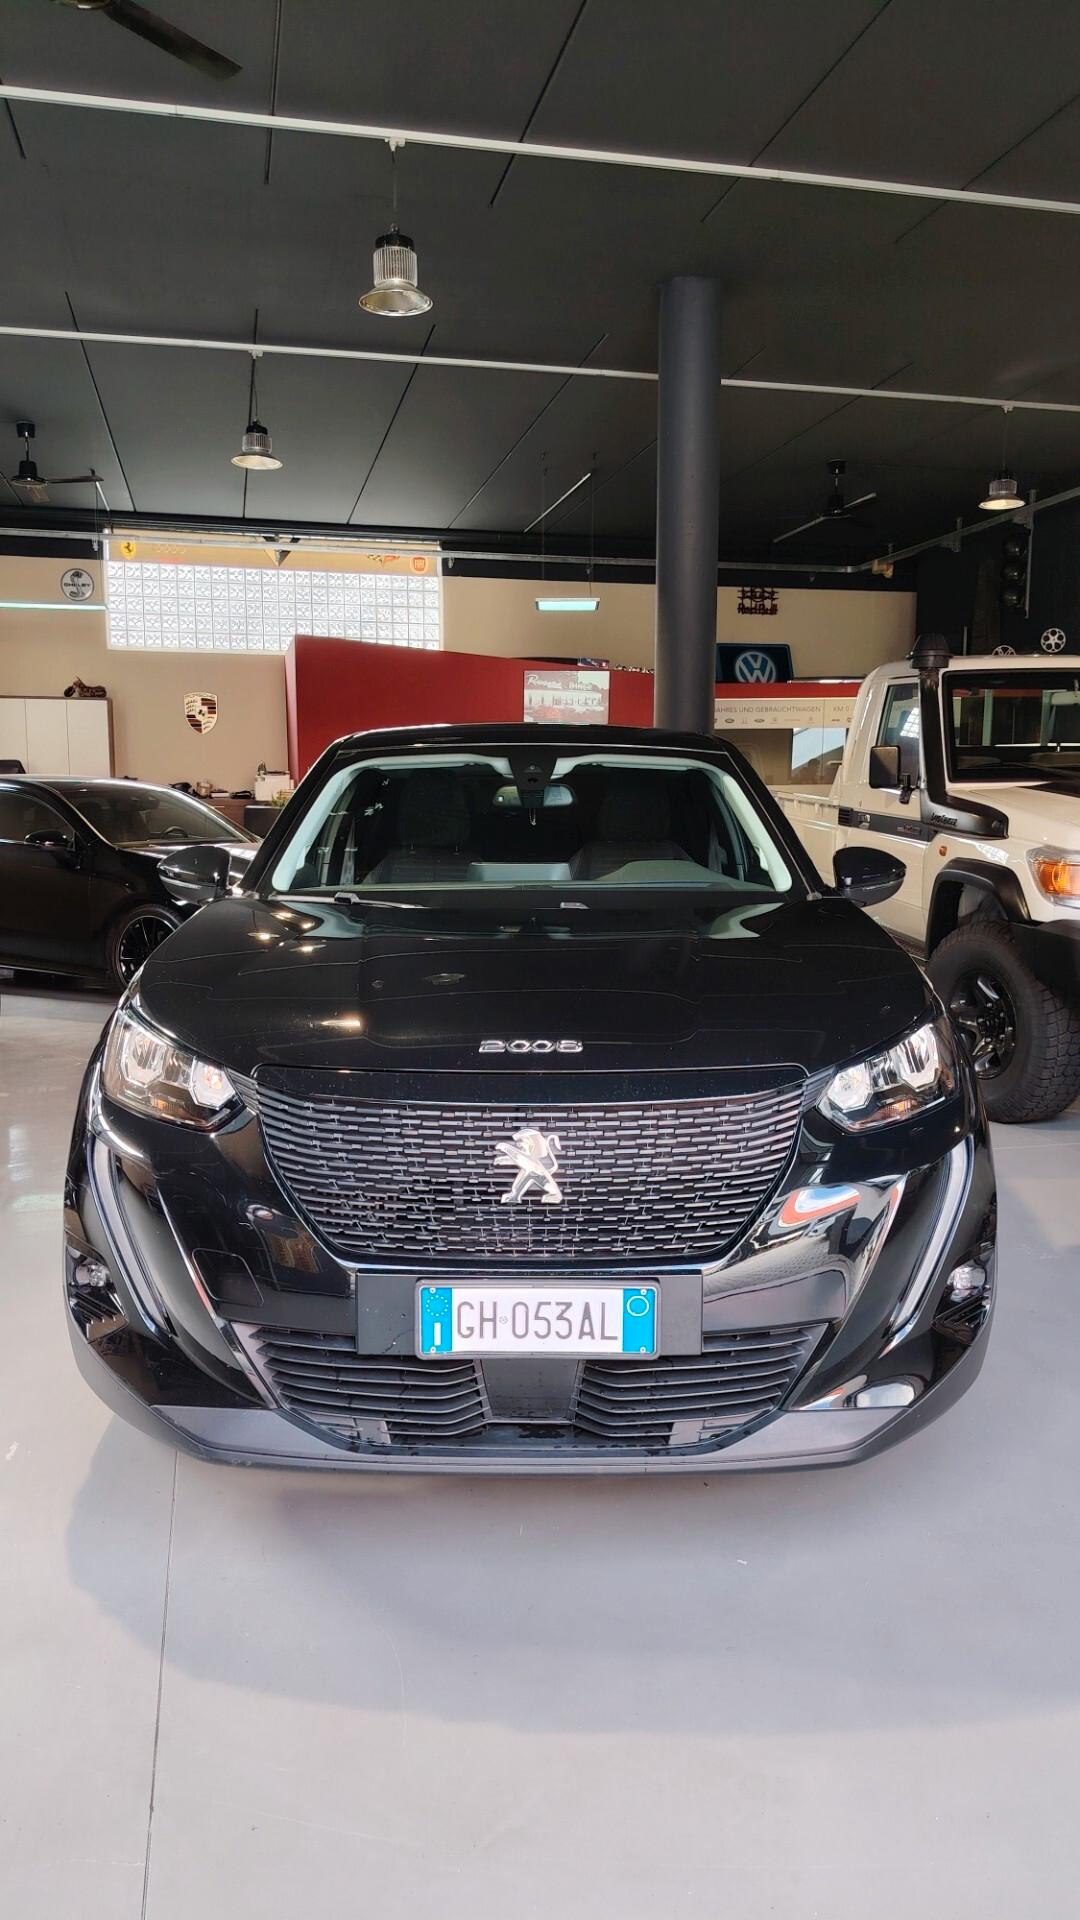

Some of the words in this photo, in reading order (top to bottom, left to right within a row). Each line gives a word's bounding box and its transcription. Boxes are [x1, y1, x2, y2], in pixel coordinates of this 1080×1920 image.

[714, 705, 737, 713] AHRES
[739, 705, 754, 713] UND
[755, 705, 822, 713] GEBRAUCHTWAGEN
[478, 1039, 584, 1053] 2008
